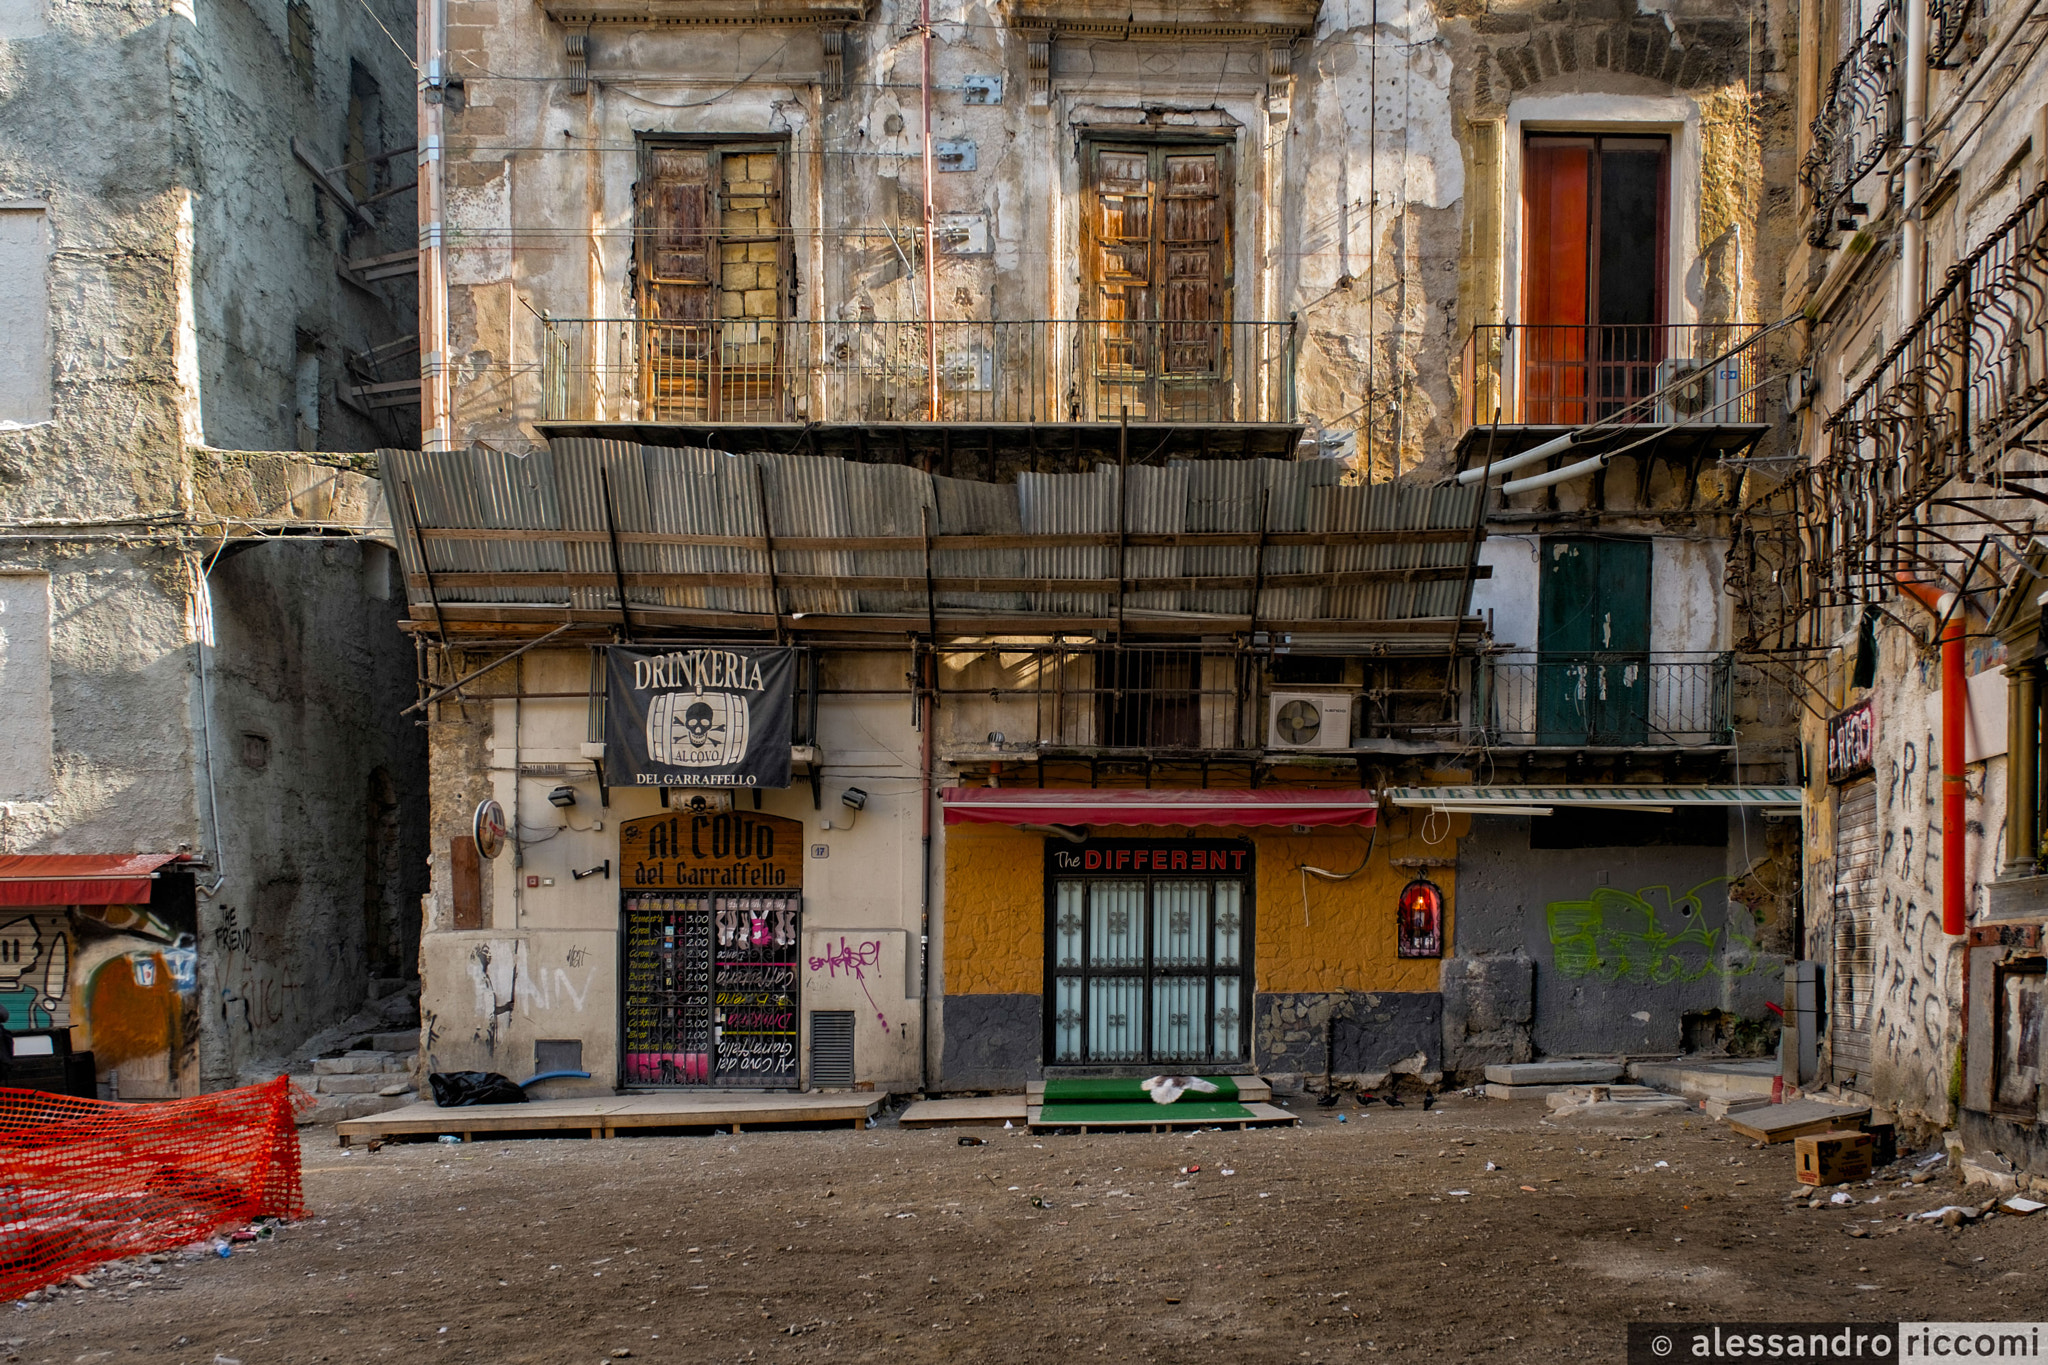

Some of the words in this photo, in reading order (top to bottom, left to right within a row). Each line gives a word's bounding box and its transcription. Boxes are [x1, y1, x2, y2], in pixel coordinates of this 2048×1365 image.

[634, 649, 765, 691] DRINKERIA
[676, 752, 689, 762] AL
[690, 750, 719, 762] COVO
[636, 773, 661, 785] DEL
[663, 774, 757, 786] GARRAFFELLO
[815, 847, 825, 857] 17
[1054, 851, 1080, 869] The
[1084, 850, 1246, 870] DIFFERENT
[635, 861, 665, 885] del
[676, 861, 785, 886] Garraffello
[219, 904, 237, 927] THE
[686, 938, 709, 947] 2.00
[717, 1038, 793, 1057] Garraffello
[715, 1057, 738, 1073] del
[740, 1057, 773, 1073] Covo
[774, 1058, 796, 1073] Al
